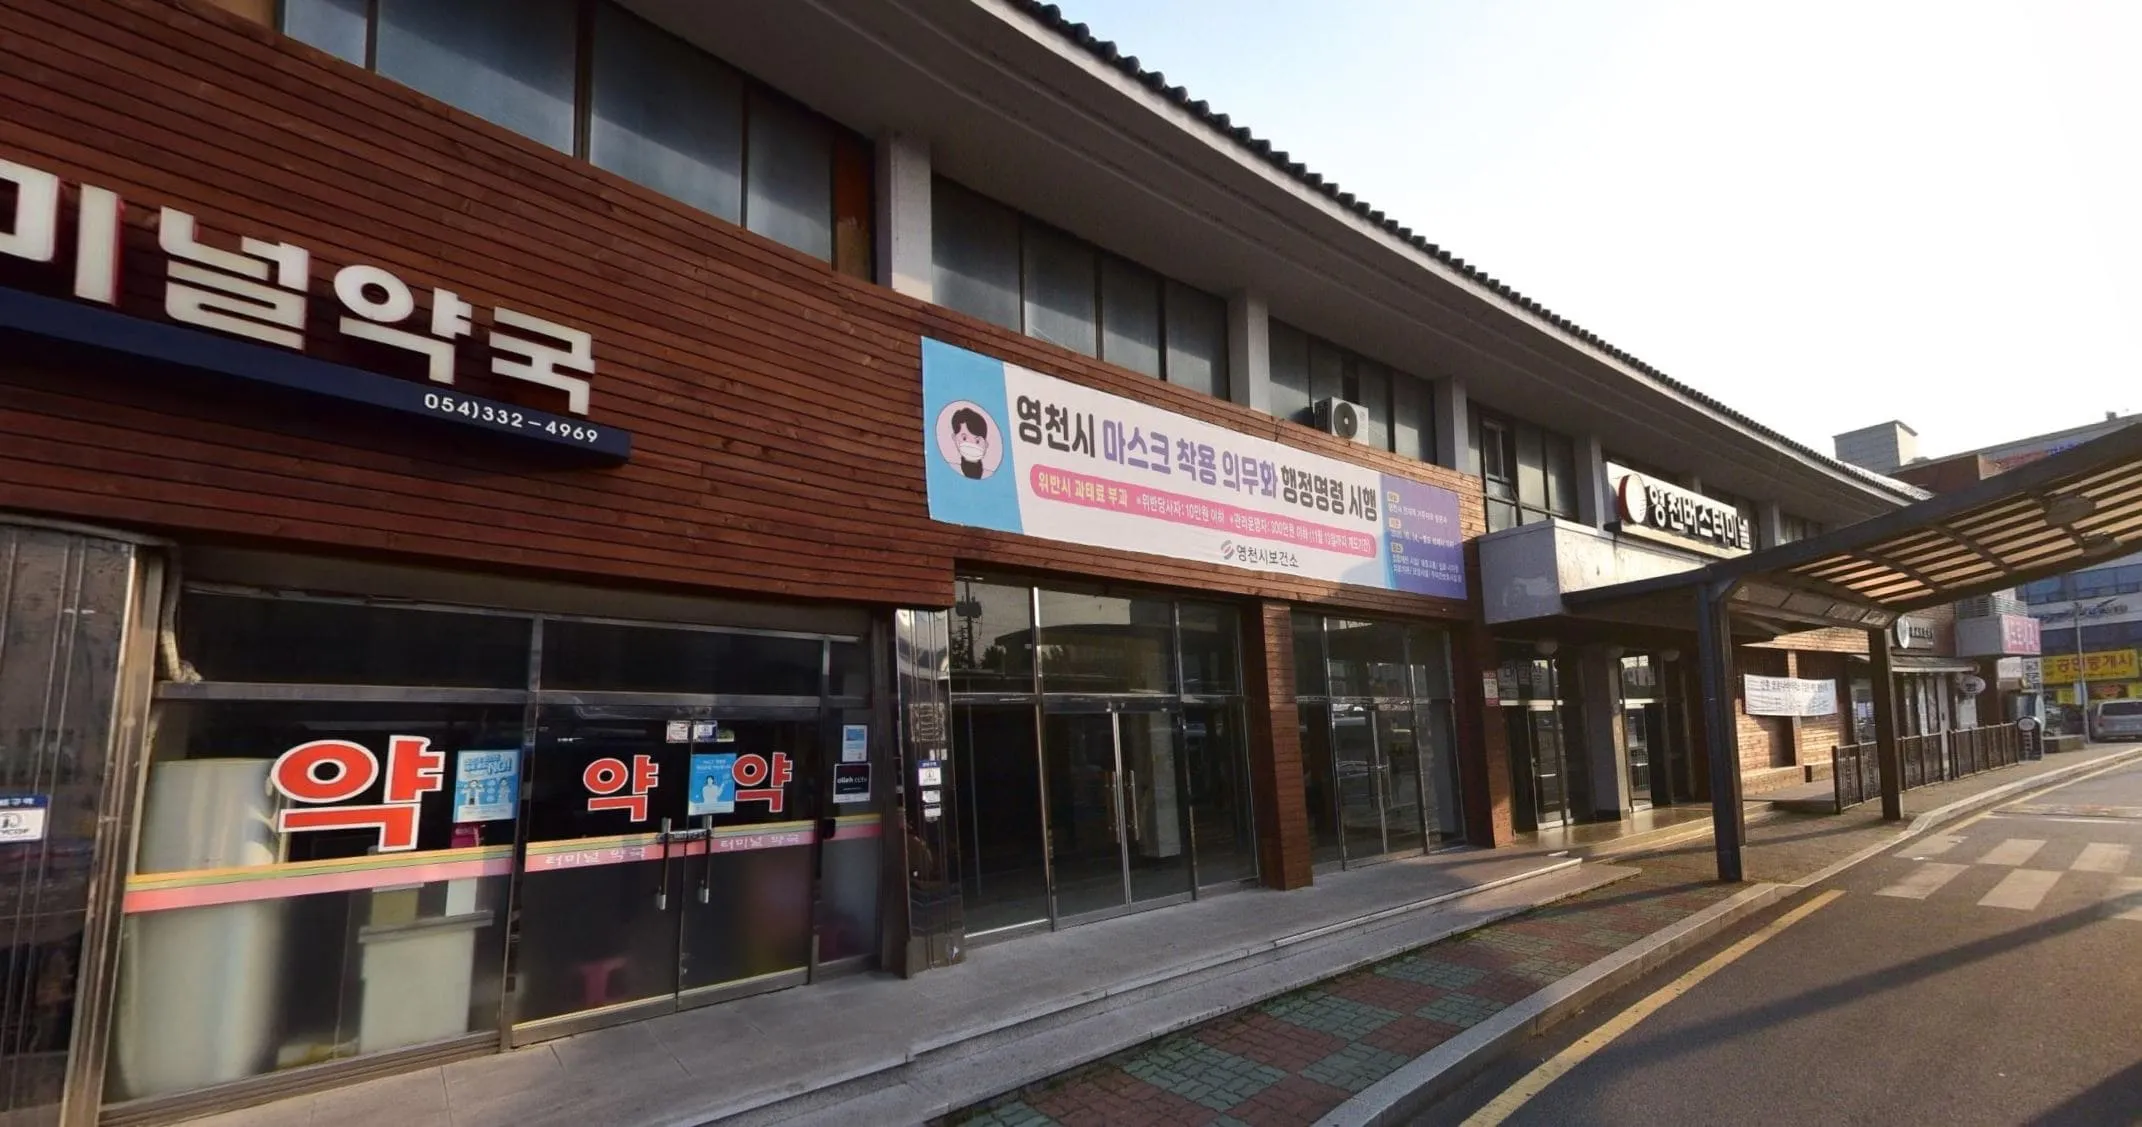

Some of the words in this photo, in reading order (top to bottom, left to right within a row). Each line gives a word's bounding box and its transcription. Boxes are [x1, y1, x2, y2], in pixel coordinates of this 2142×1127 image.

[0, 159, 595, 415] 미널약국
[425, 393, 598, 445] 054)332-4969
[1017, 395, 1096, 458] 영천시
[1103, 419, 1171, 475] 마스크
[1176, 438, 1217, 486] 착용
[1222, 451, 1279, 499] 의무화
[1281, 465, 1345, 515] 행정명령
[1349, 484, 1378, 522] 시행
[1038, 471, 1071, 498] 위반시
[1075, 480, 1105, 503] 과태료
[1108, 488, 1128, 507] 부과
[1649, 484, 1751, 550] 영천버스터미널
[1236, 544, 1299, 568] 영천시보건소
[271, 735, 446, 852] 약
[583, 755, 659, 823] 약
[732, 752, 793, 813] 약
[545, 850, 600, 866] 터미널
[720, 836, 763, 850] 터미널
